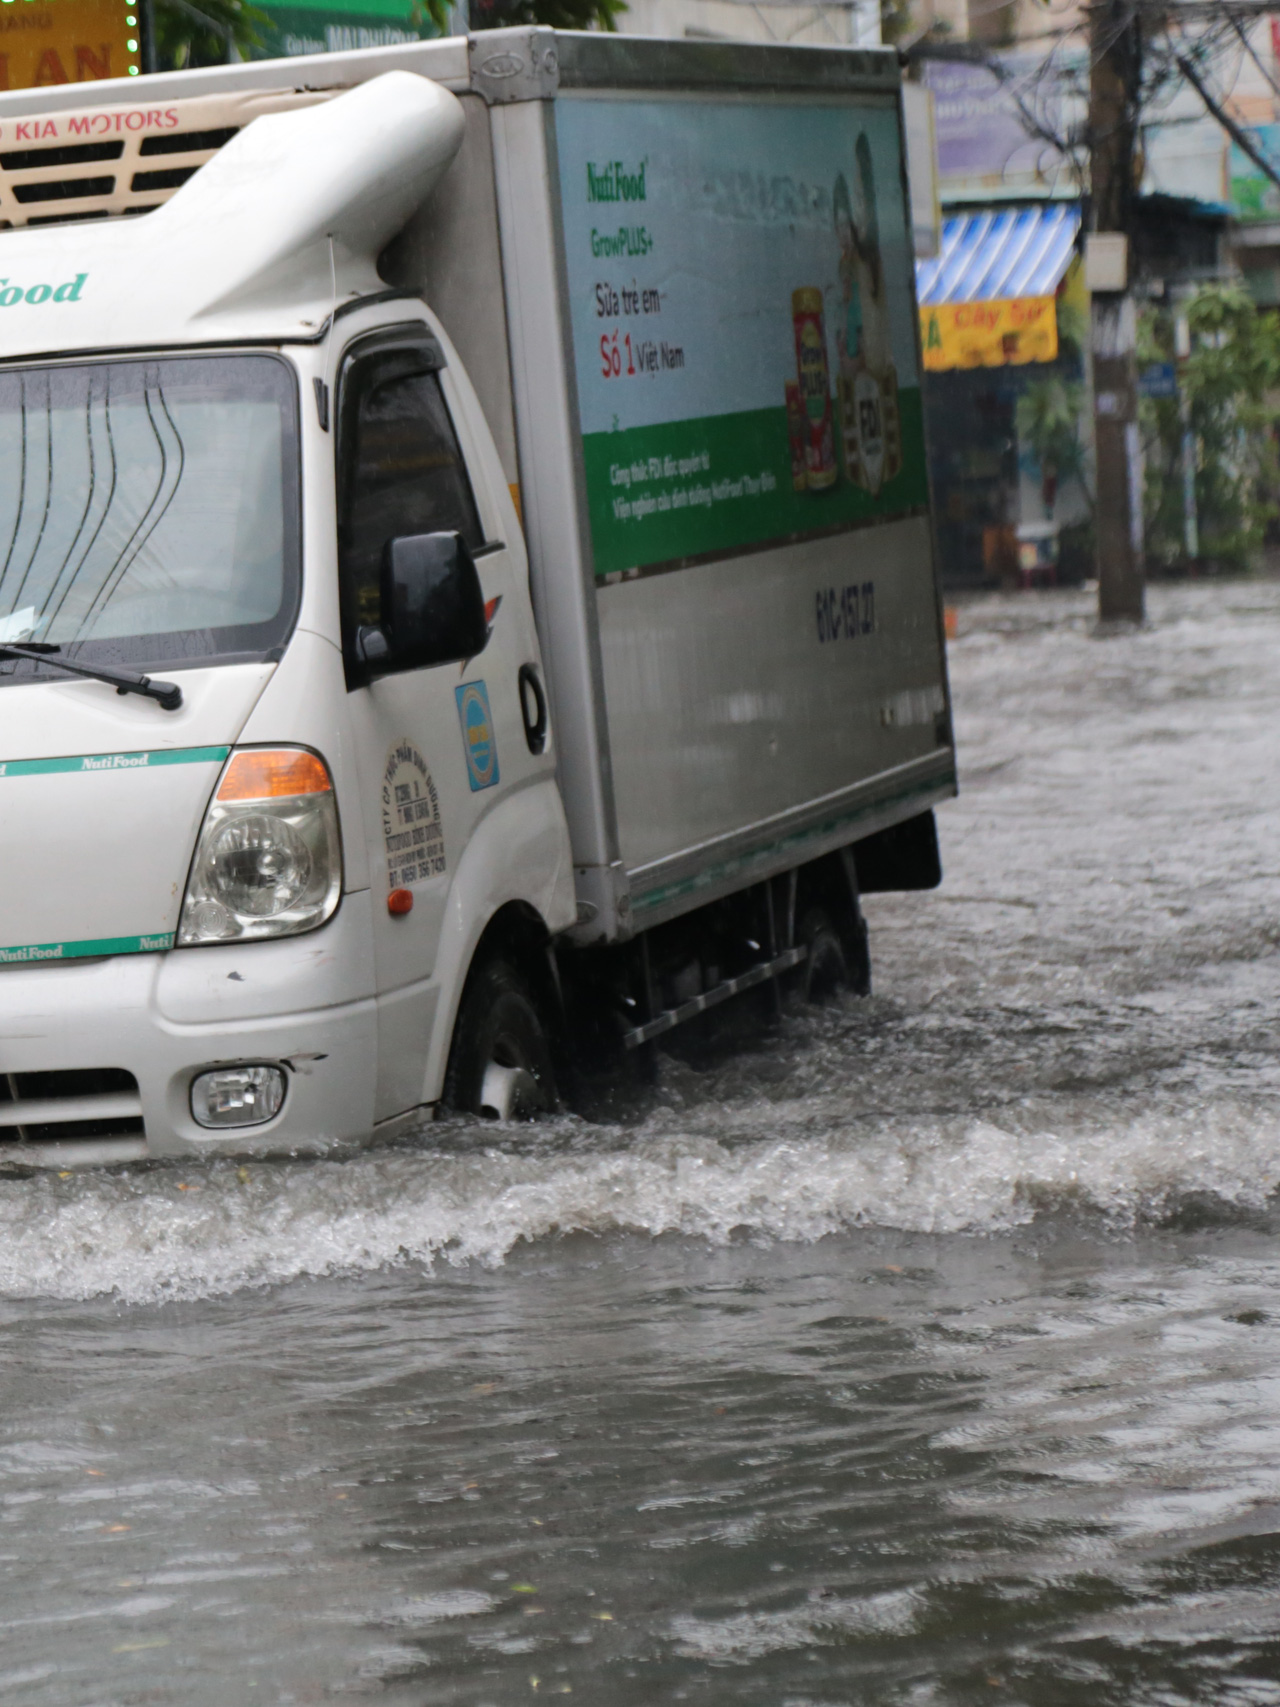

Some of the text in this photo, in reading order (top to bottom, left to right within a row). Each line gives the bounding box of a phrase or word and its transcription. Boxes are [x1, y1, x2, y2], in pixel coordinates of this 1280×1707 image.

[15, 119, 59, 142] KIA
[67, 107, 179, 136] MOTORS
[587, 160, 647, 202] NutiFood
[591, 226, 653, 258] GrowPLUS+
[642, 288, 661, 314] em
[600, 328, 685, 379] Số 1 Việt Nam
[81, 753, 150, 771] NutiFood
